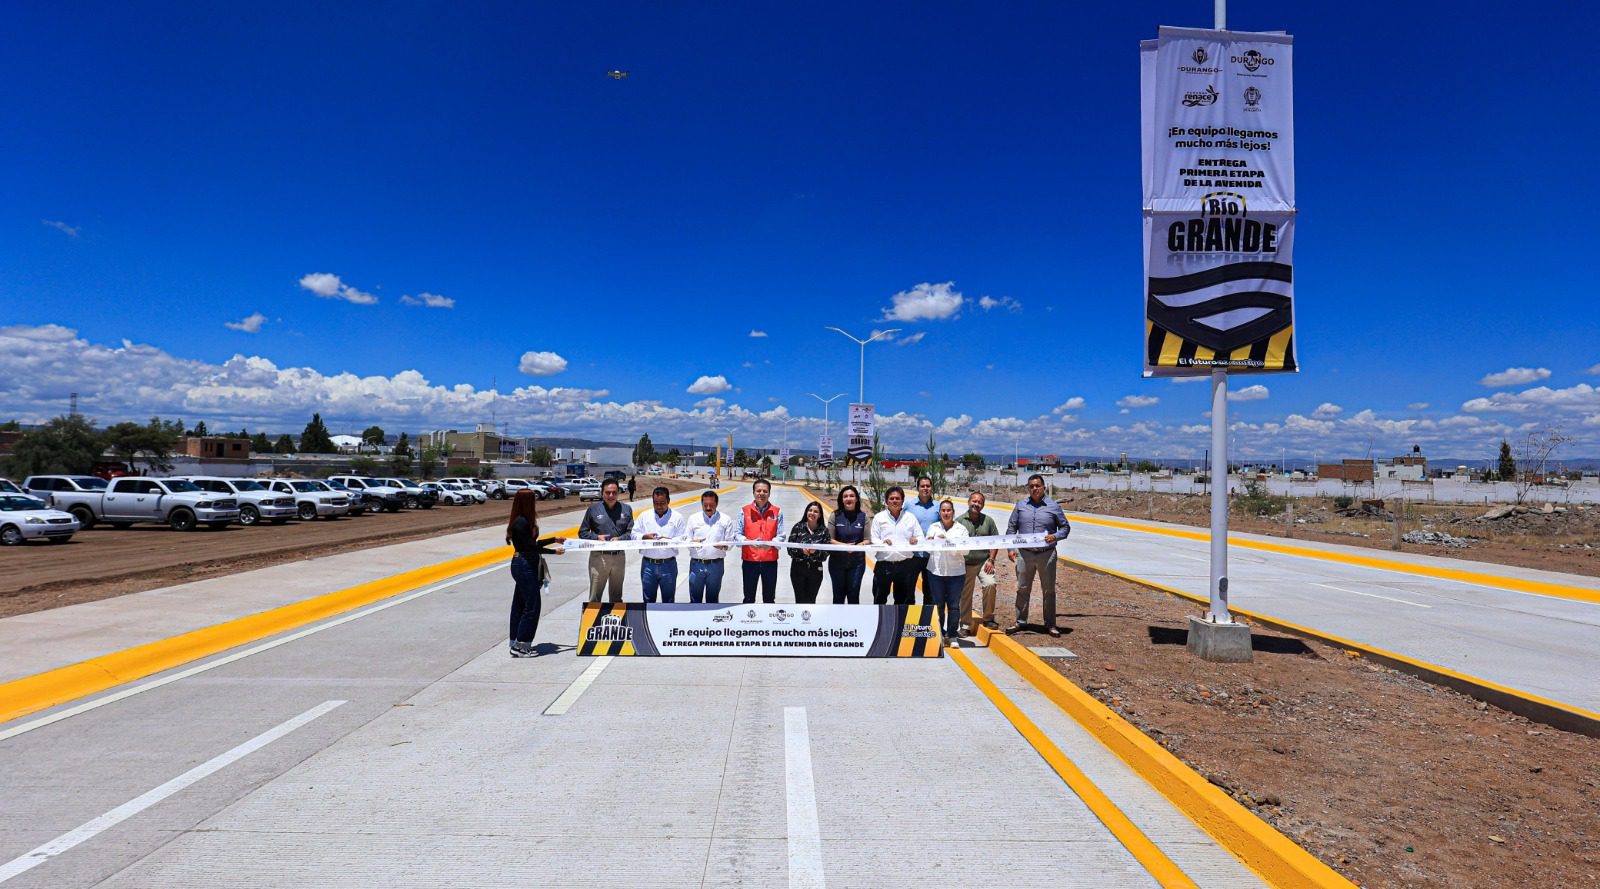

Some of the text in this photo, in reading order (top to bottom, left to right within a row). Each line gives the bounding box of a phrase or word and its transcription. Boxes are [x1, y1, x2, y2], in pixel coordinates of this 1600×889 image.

[1230, 56, 1274, 66] DURANGO
[1168, 126, 1278, 138] ¡En equipo llegamos
[1176, 138, 1270, 151] mucho más lejos!
[1198, 159, 1247, 168] ENTREGA
[1180, 168, 1228, 176] PRIMERA
[1209, 198, 1238, 215] Río
[1168, 218, 1278, 252] GRANDE
[605, 617, 617, 626] Río
[587, 627, 632, 640] GRANDE
[670, 627, 858, 638] ¡En equipo llegamos mucho más lejos!
